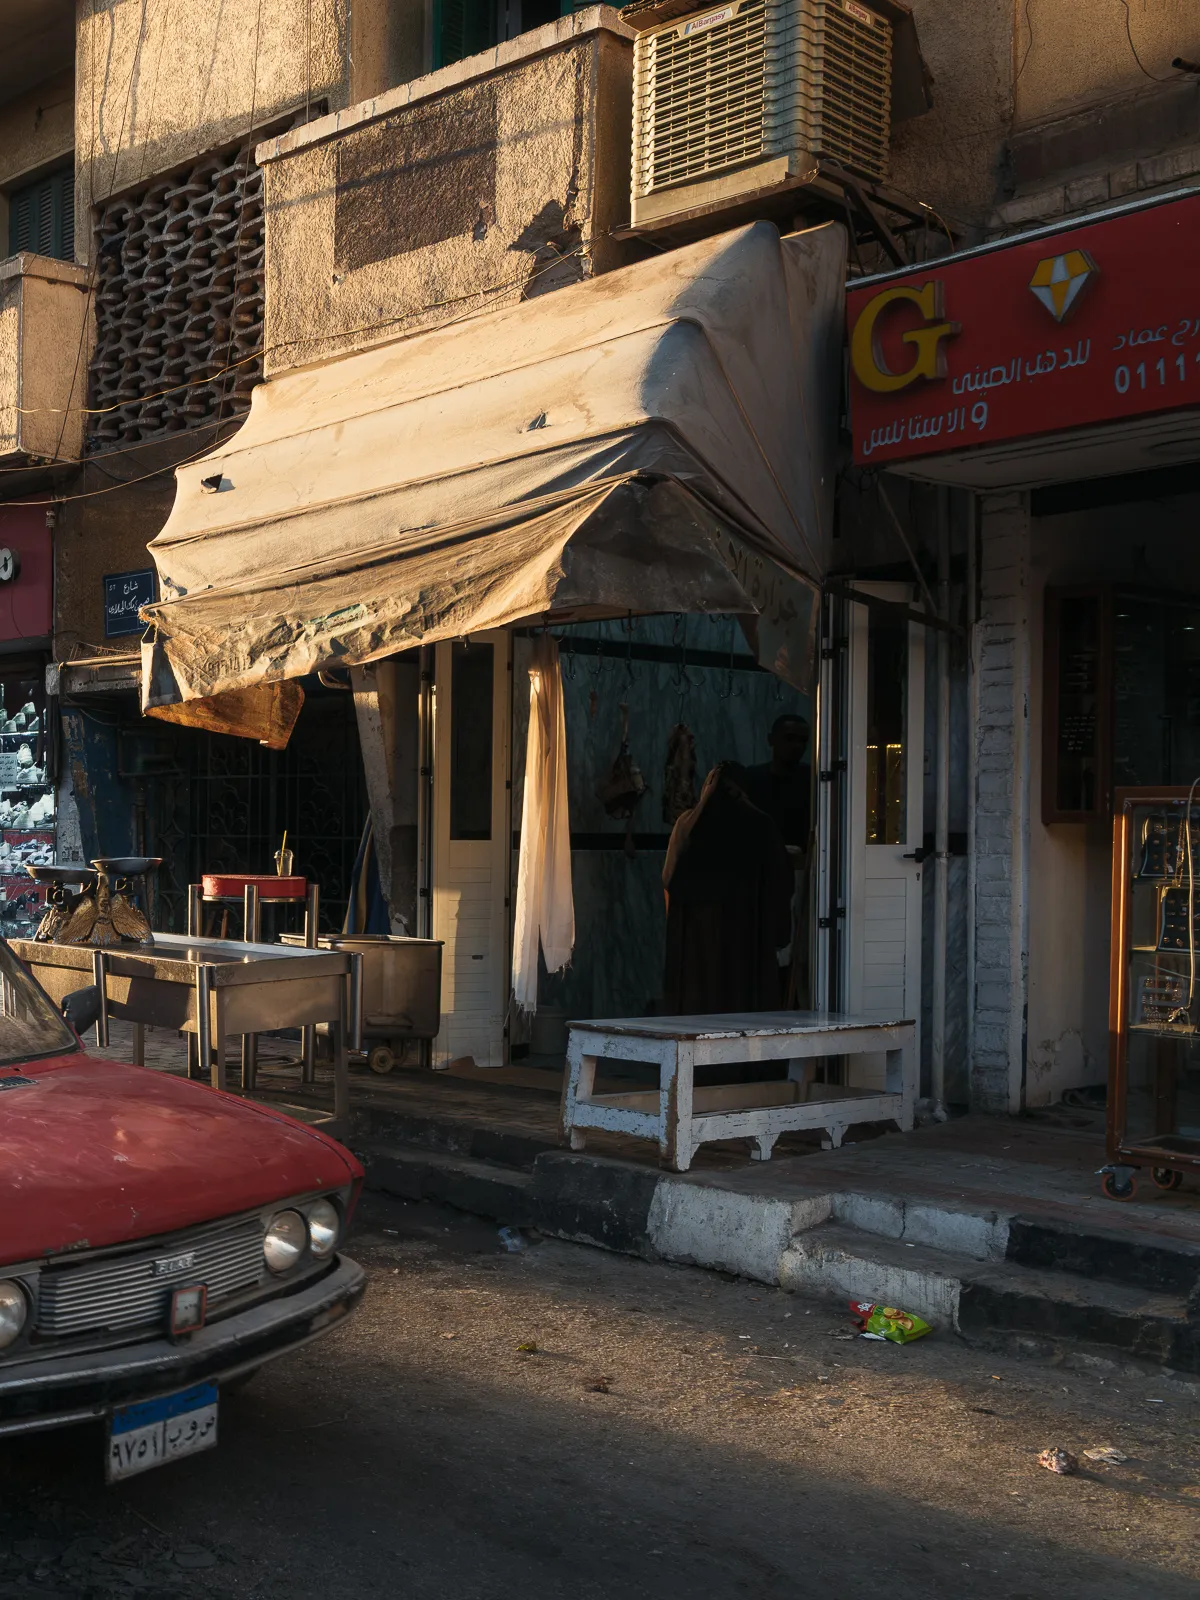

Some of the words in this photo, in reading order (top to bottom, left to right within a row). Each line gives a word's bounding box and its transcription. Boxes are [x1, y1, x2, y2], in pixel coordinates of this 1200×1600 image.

[852, 281, 950, 391] G
[1112, 324, 1168, 350] عماد
[971, 401, 989, 430] و
[123, 580, 139, 595] شارع
